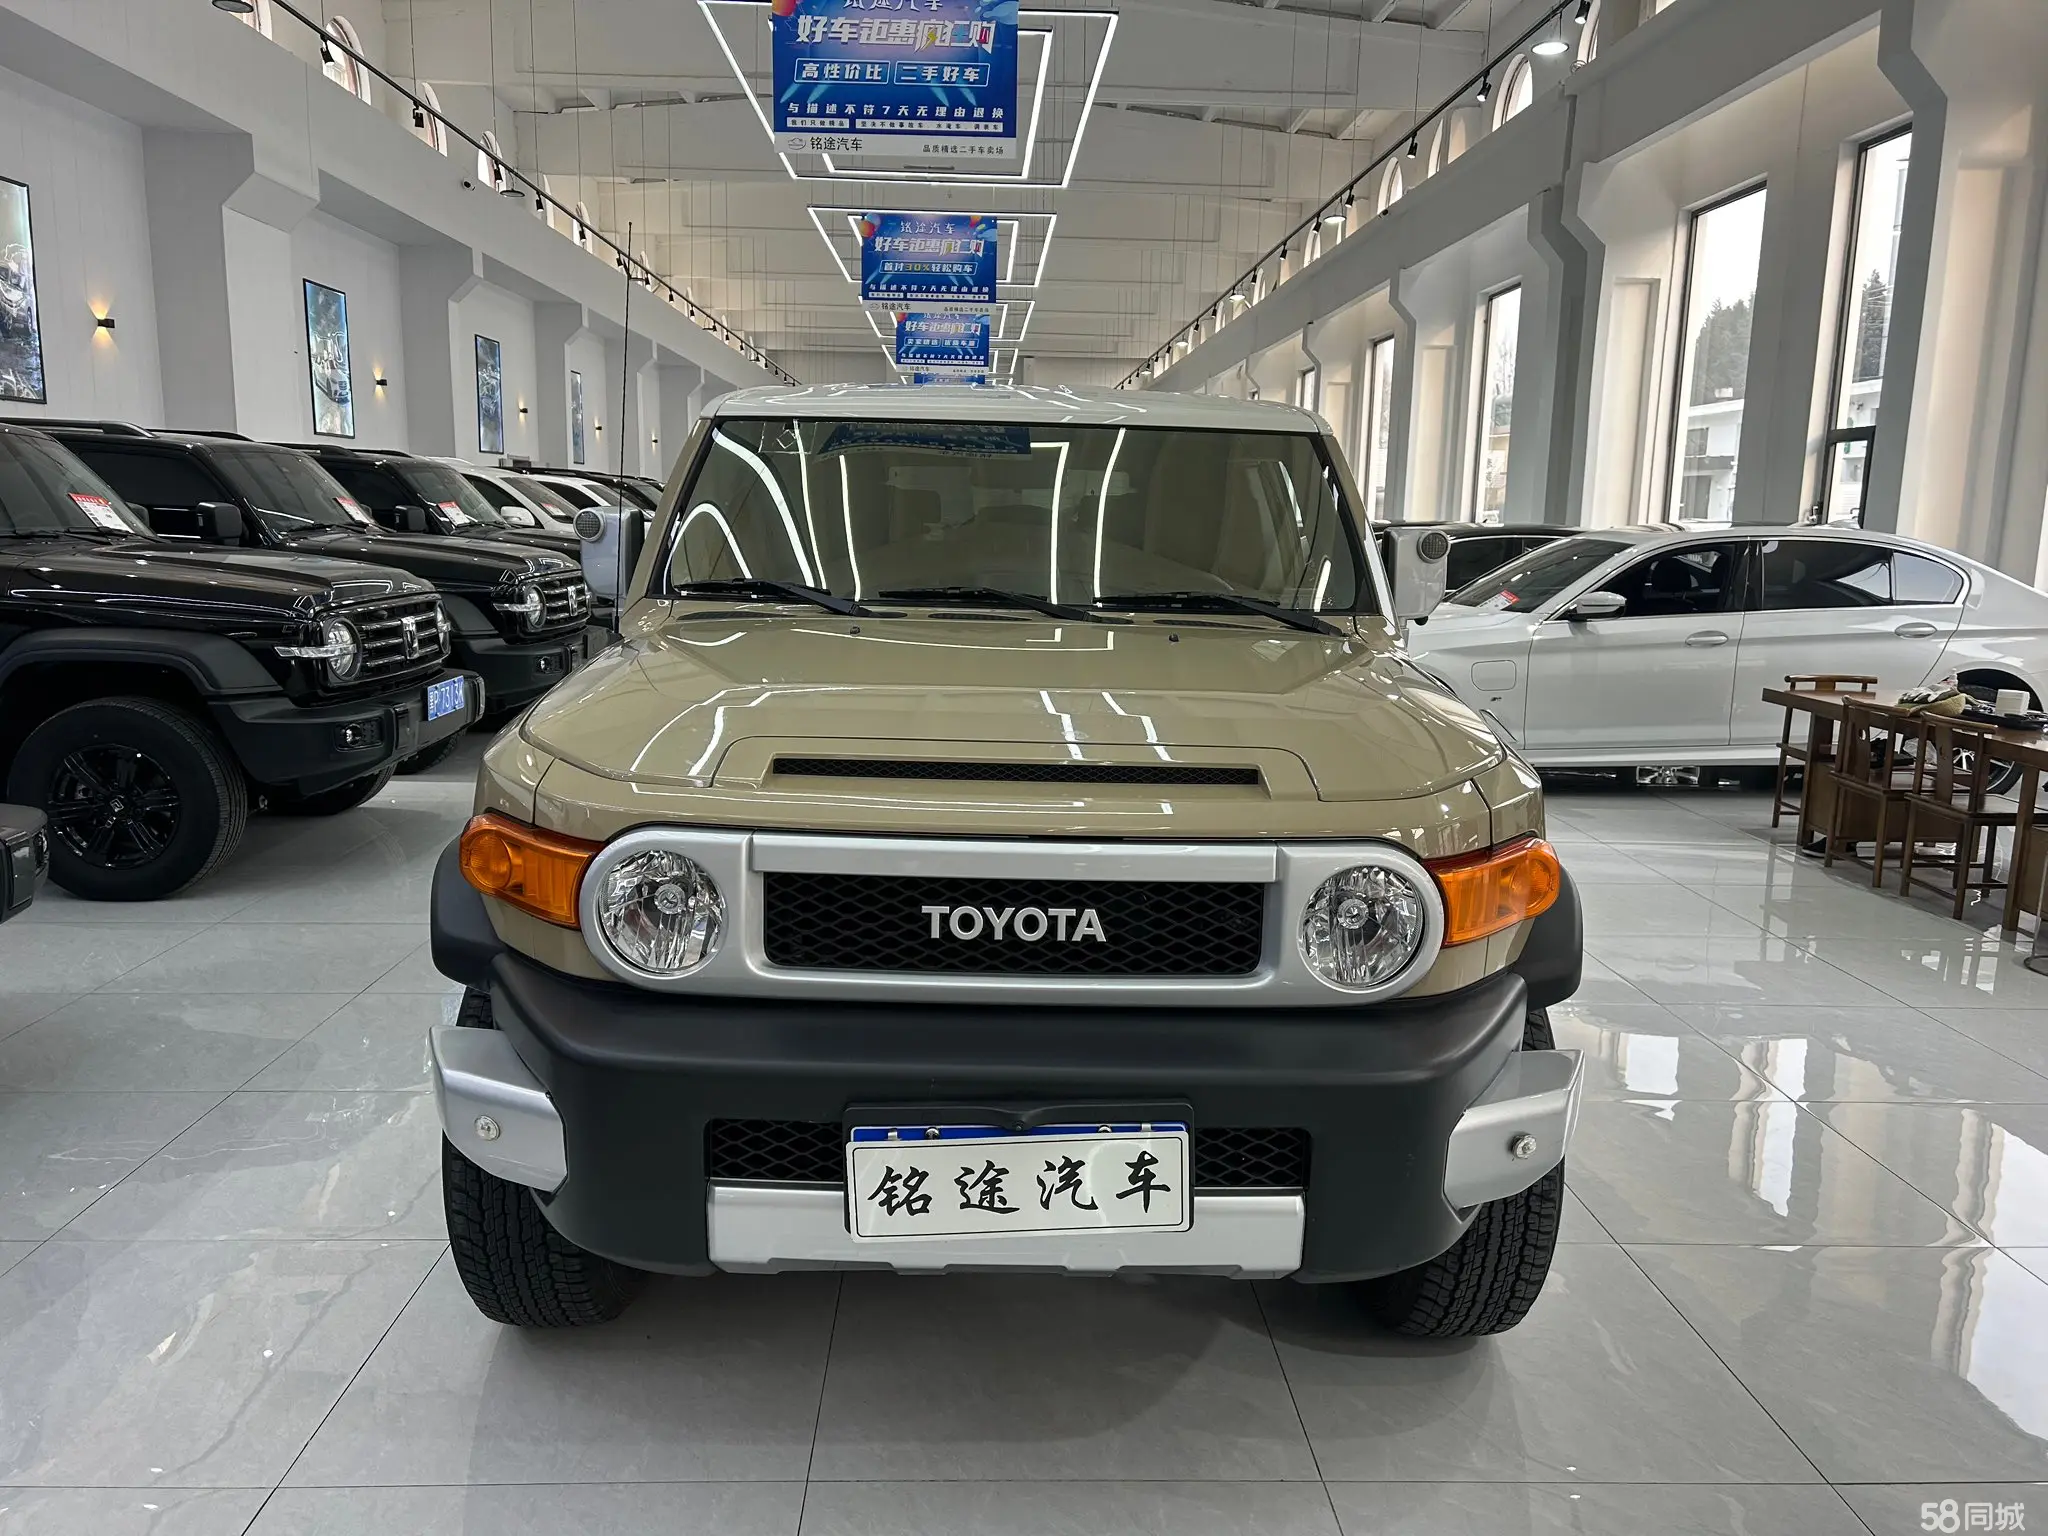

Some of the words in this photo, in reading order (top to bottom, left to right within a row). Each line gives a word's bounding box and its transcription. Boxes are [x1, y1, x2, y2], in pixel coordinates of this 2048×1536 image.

[796, 15, 996, 54] 好车钜惠疯狂购
[801, 62, 883, 81] 高性价比
[901, 65, 981, 82] 二手好车
[787, 103, 1004, 119] 与描述不符7天无理由退换
[810, 137, 863, 151] 铭途汽车
[921, 905, 1107, 942] TOYOTA
[867, 1150, 1171, 1217] 铭途汽车
